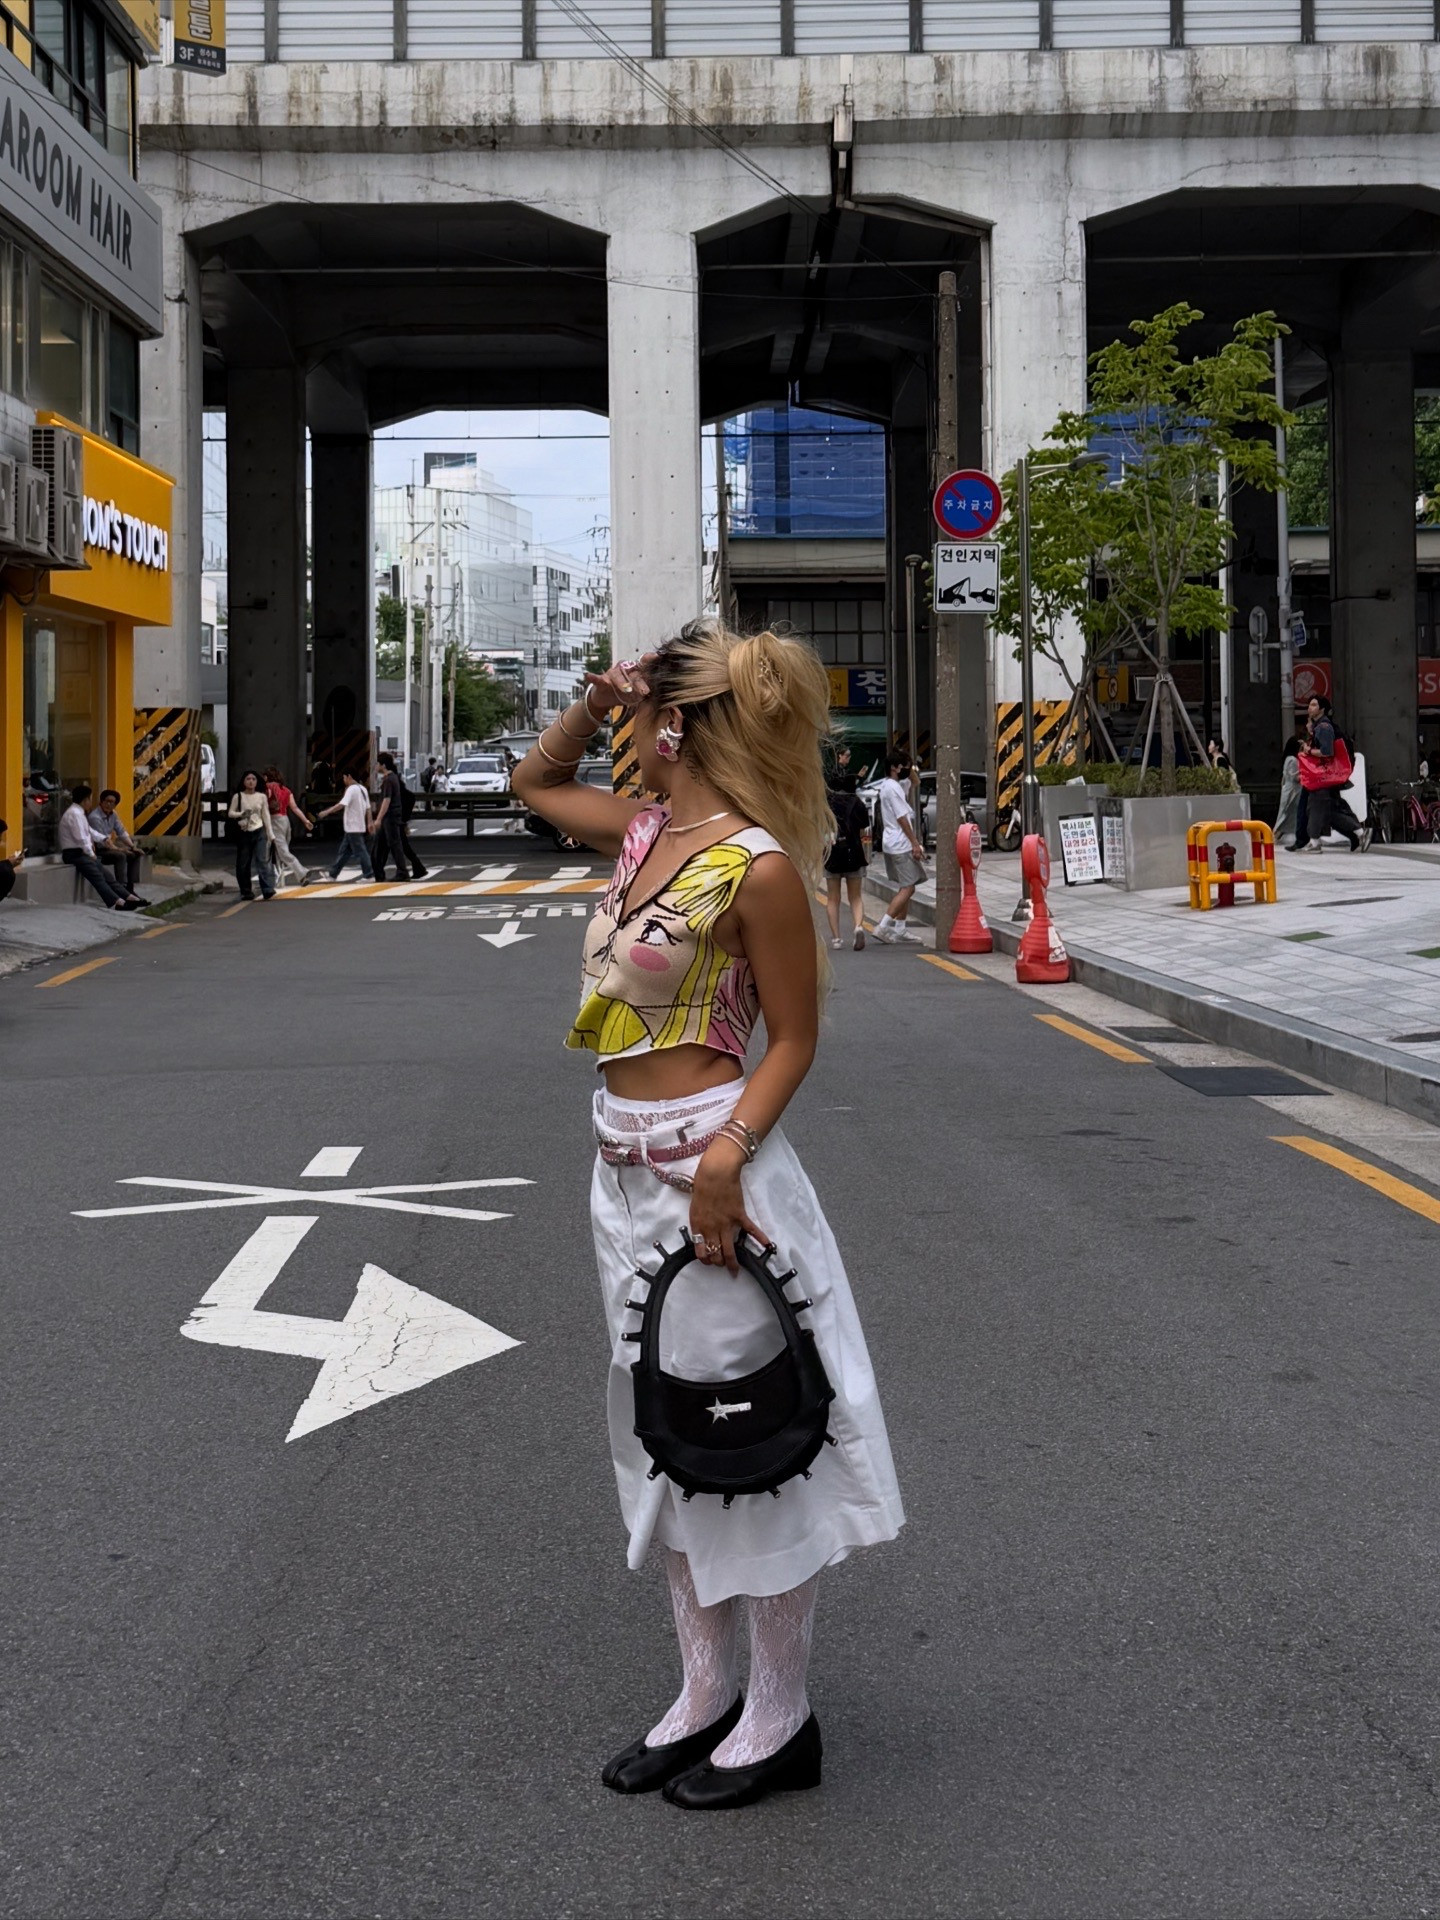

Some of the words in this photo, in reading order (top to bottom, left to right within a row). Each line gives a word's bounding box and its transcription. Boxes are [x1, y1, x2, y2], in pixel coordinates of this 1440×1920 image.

[179, 45, 195, 61] 3F
[0, 97, 82, 226] AROOM
[90, 178, 132, 271] HAIR
[944, 499, 993, 512] 주차금지
[123, 513, 168, 572] TOUCH
[940, 548, 996, 563] 견인지역
[372, 903, 600, 921] 방통행
